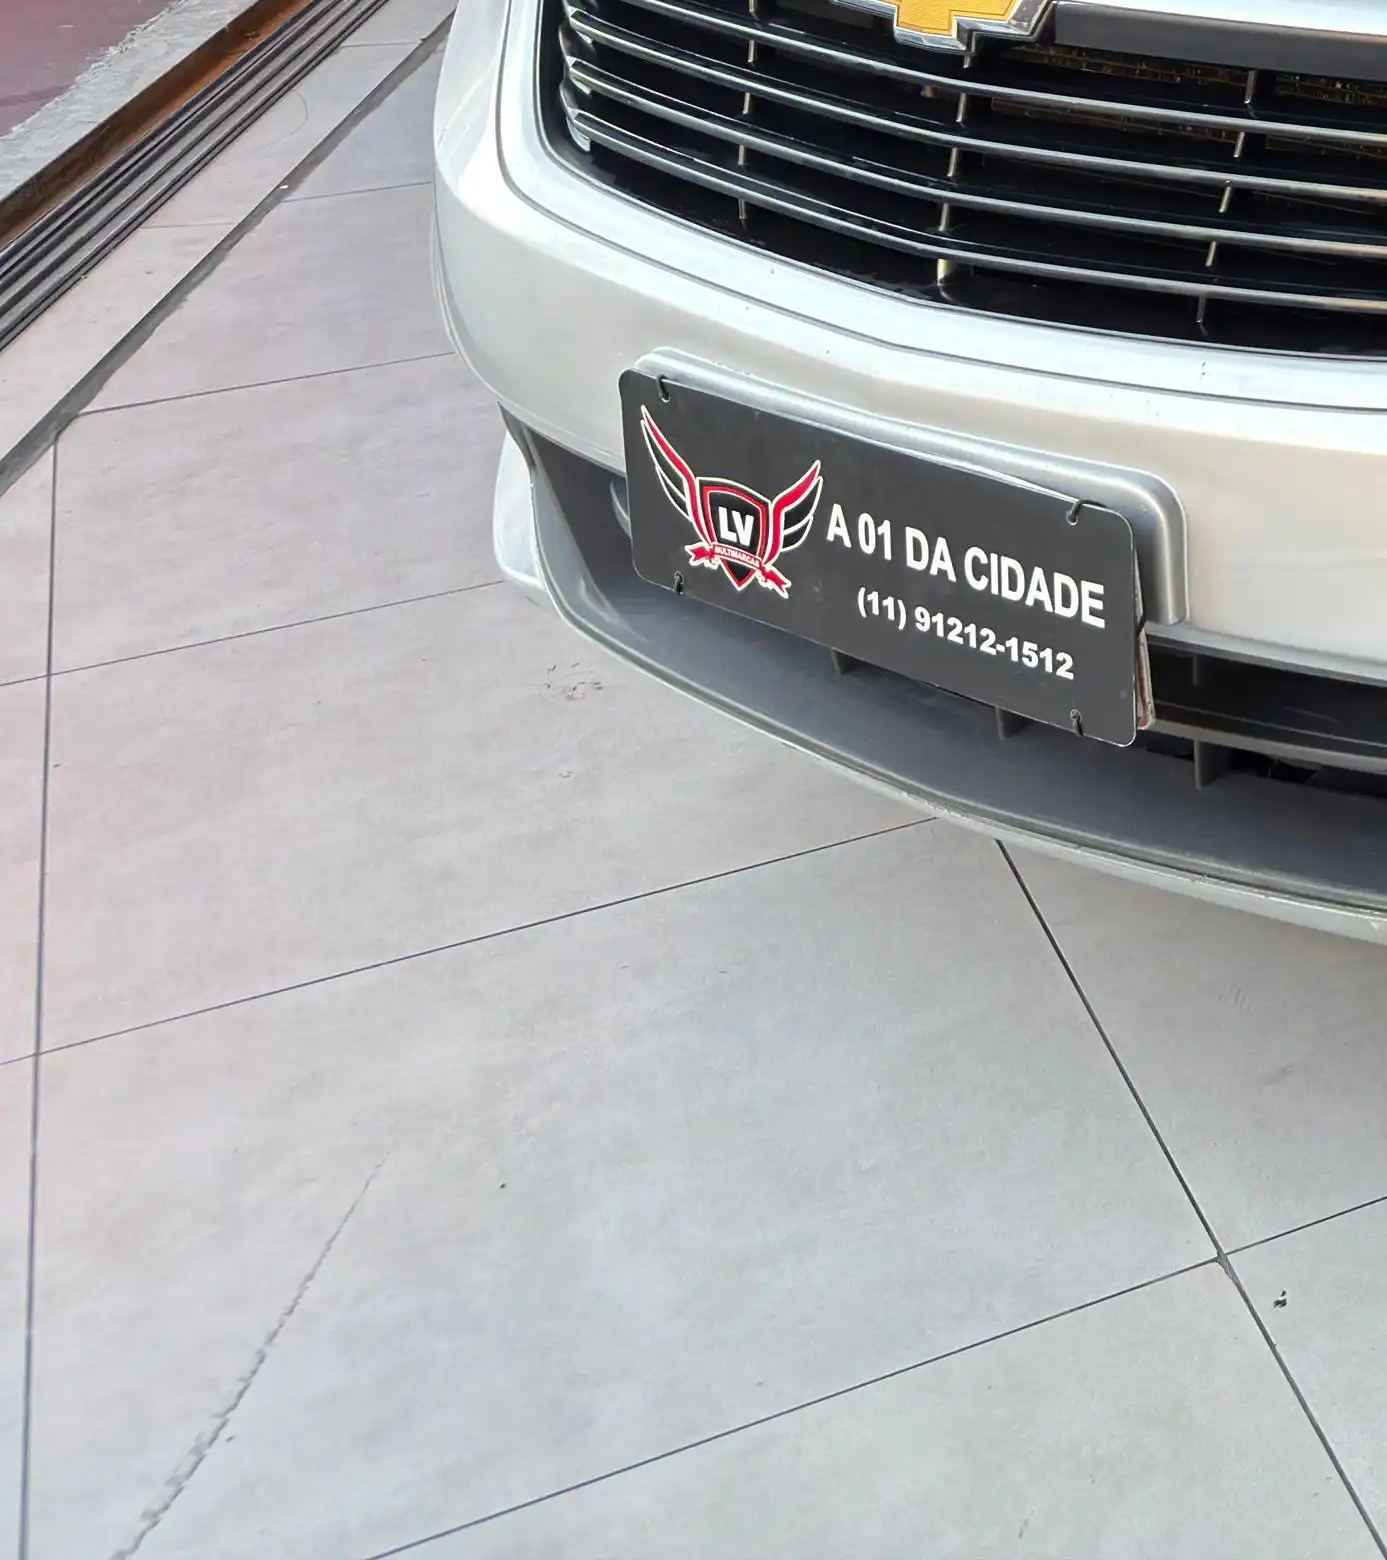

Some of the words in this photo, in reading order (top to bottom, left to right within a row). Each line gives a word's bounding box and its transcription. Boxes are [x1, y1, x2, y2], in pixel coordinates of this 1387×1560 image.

[718, 506, 755, 547] LV
[826, 503, 852, 549] A
[857, 512, 892, 561] 01
[905, 526, 957, 583] DA
[963, 546, 1107, 629] CIDADE
[857, 586, 907, 631] (11)
[913, 606, 1075, 681] 91212-1512
